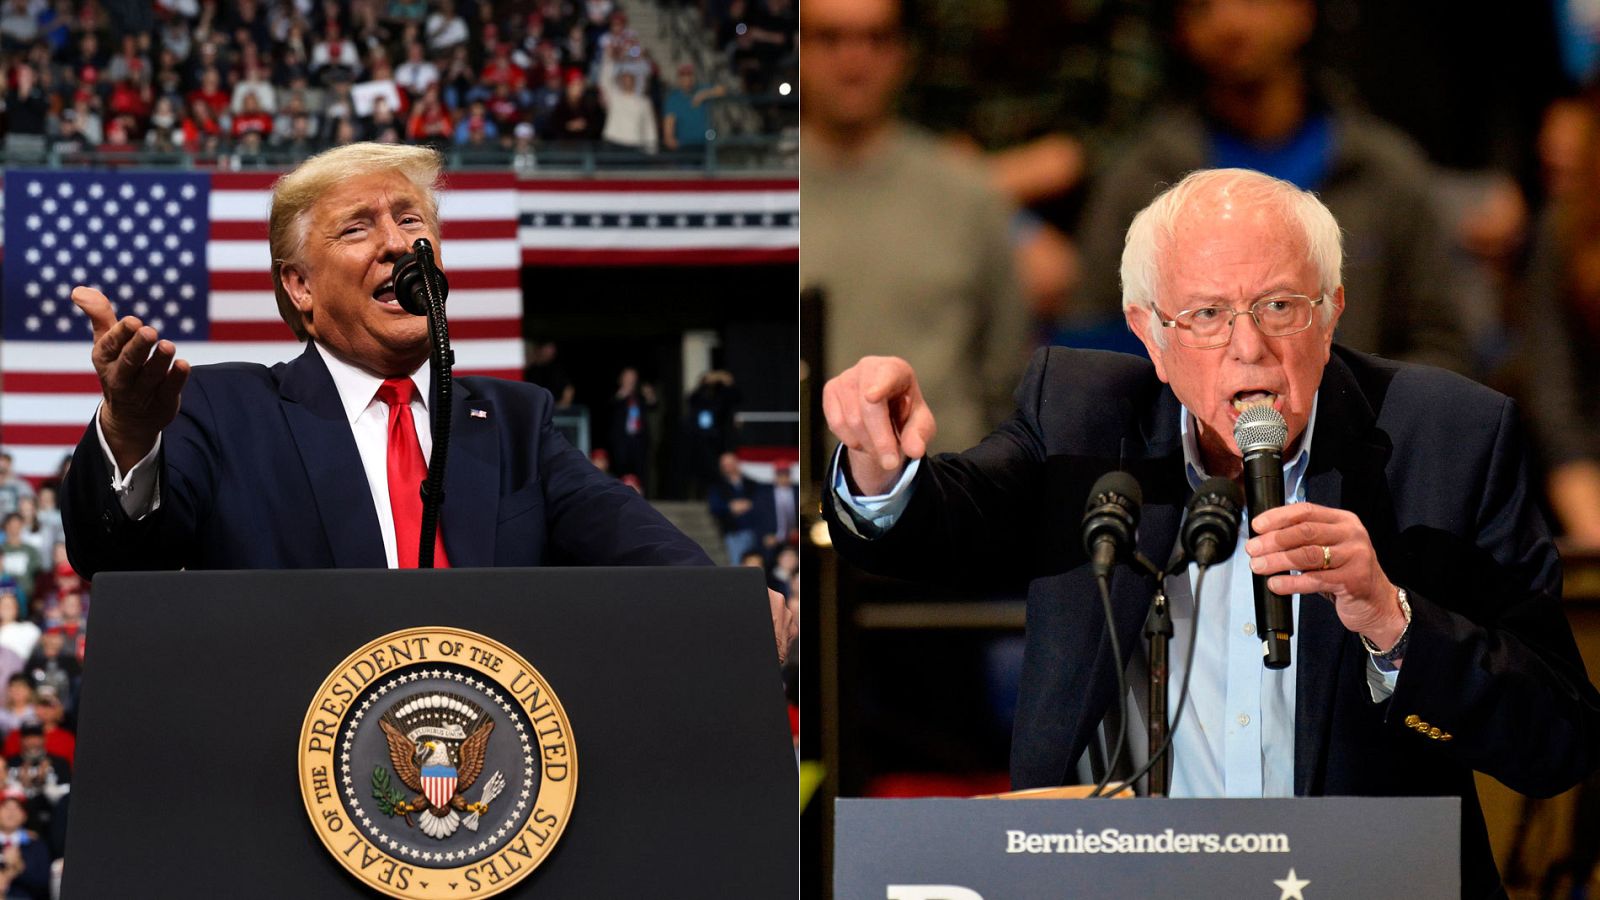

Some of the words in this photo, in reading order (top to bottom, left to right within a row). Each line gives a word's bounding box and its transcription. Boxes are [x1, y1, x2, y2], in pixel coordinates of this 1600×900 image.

[438, 640, 464, 657] OF
[470, 646, 503, 673] THE
[308, 637, 430, 755] PRESIDENT
[510, 669, 568, 782] UNITED
[312, 765, 332, 803] THE
[322, 808, 343, 832] OF
[464, 808, 558, 892] STATES
[1006, 828, 1290, 853] BernieSanders.com
[343, 833, 413, 890] SEAL
